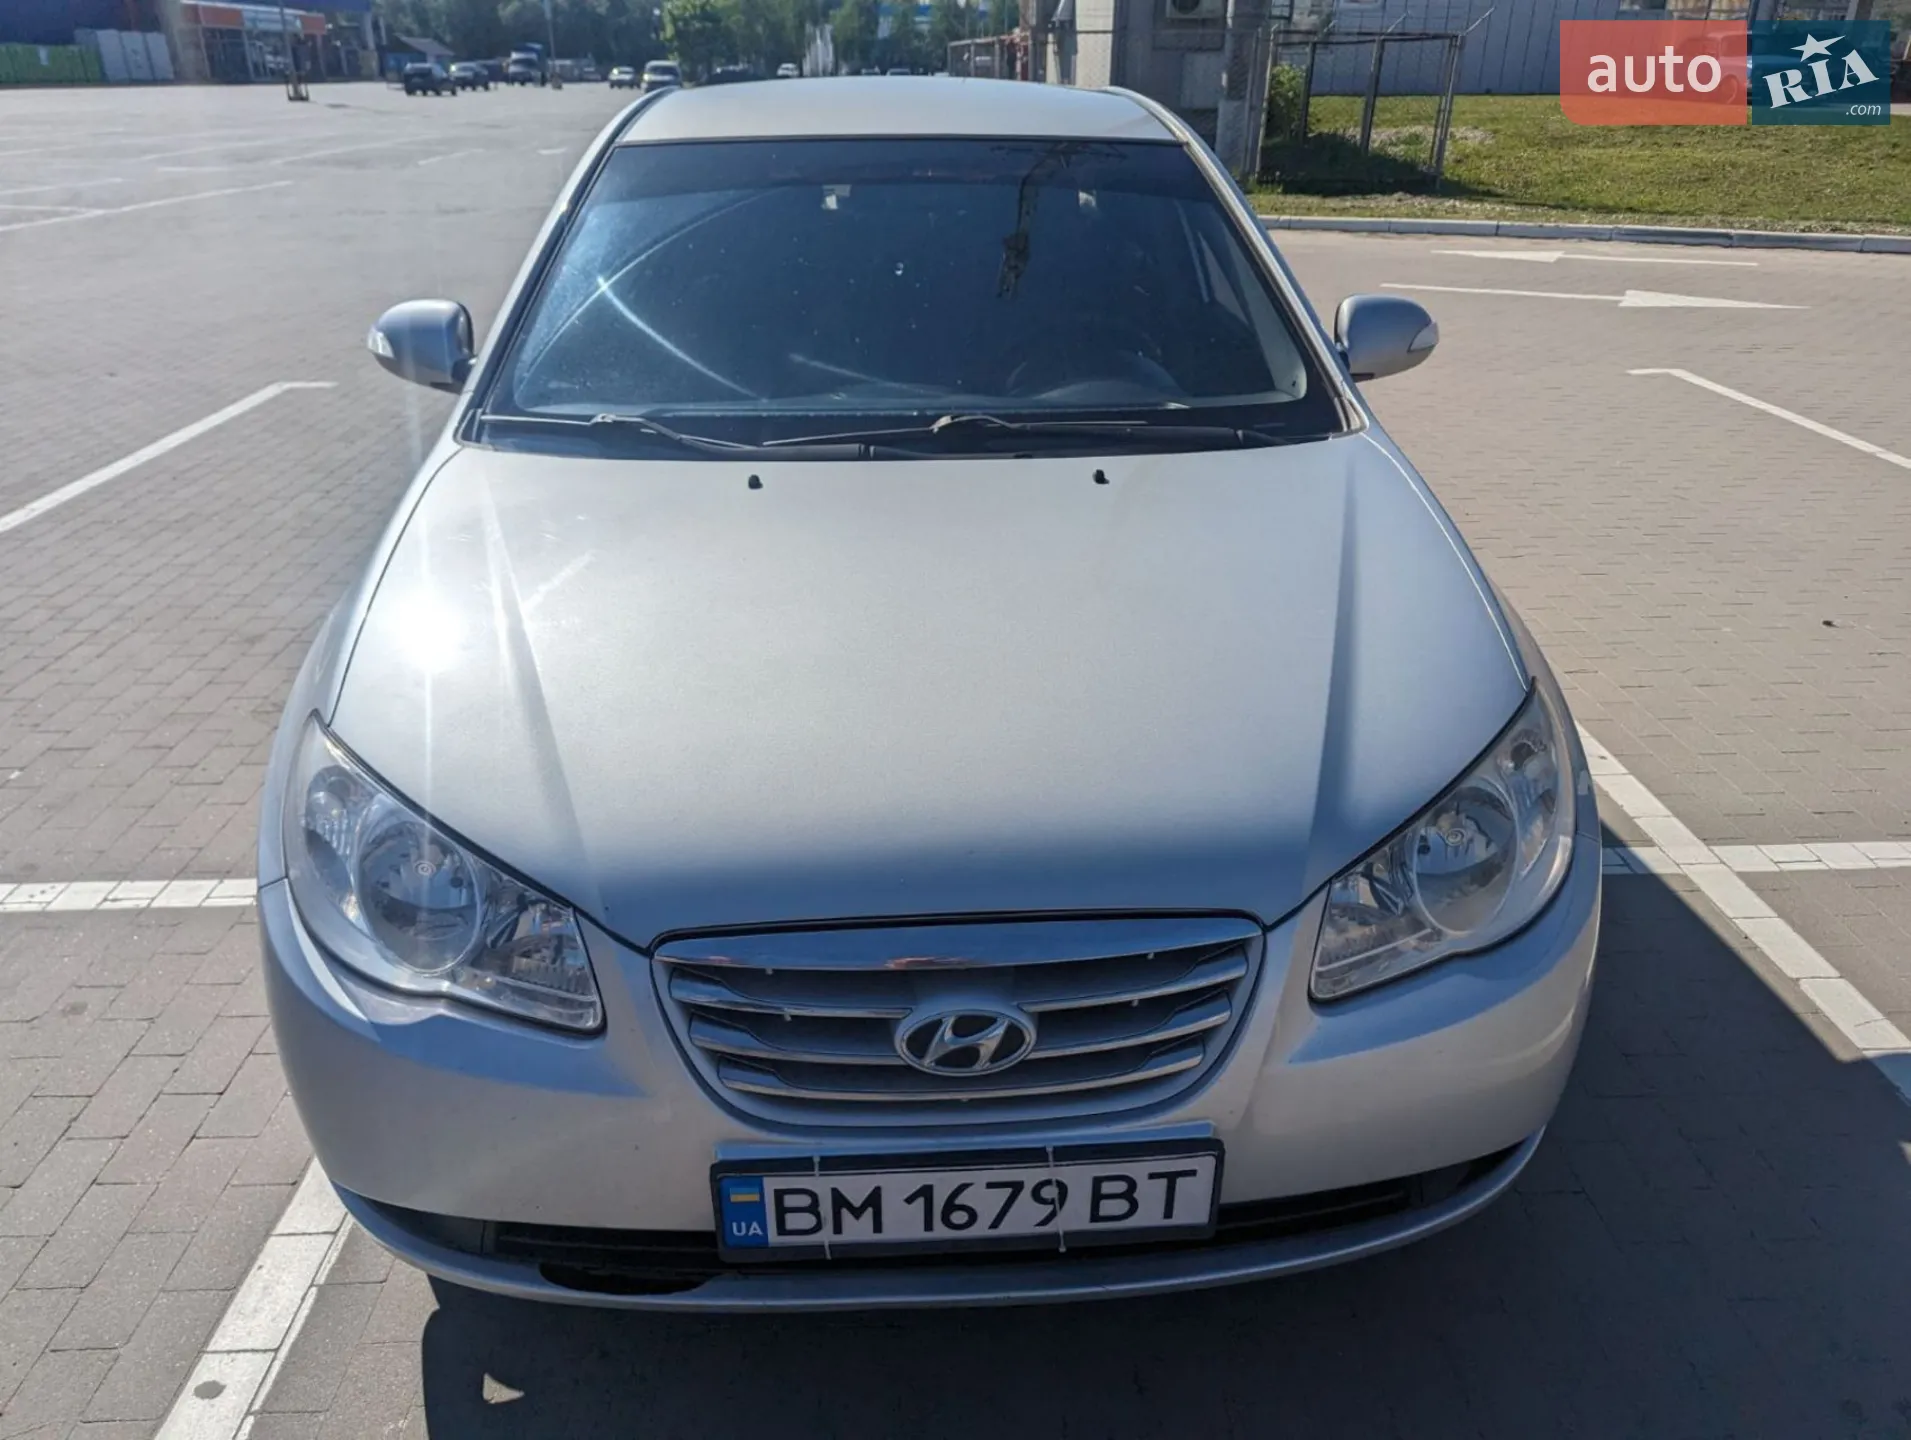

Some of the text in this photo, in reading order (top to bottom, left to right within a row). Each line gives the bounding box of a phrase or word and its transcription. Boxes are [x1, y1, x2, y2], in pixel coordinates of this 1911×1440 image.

[774, 1169, 1198, 1236] BM 1679 BT
[732, 1222, 763, 1237] UA
